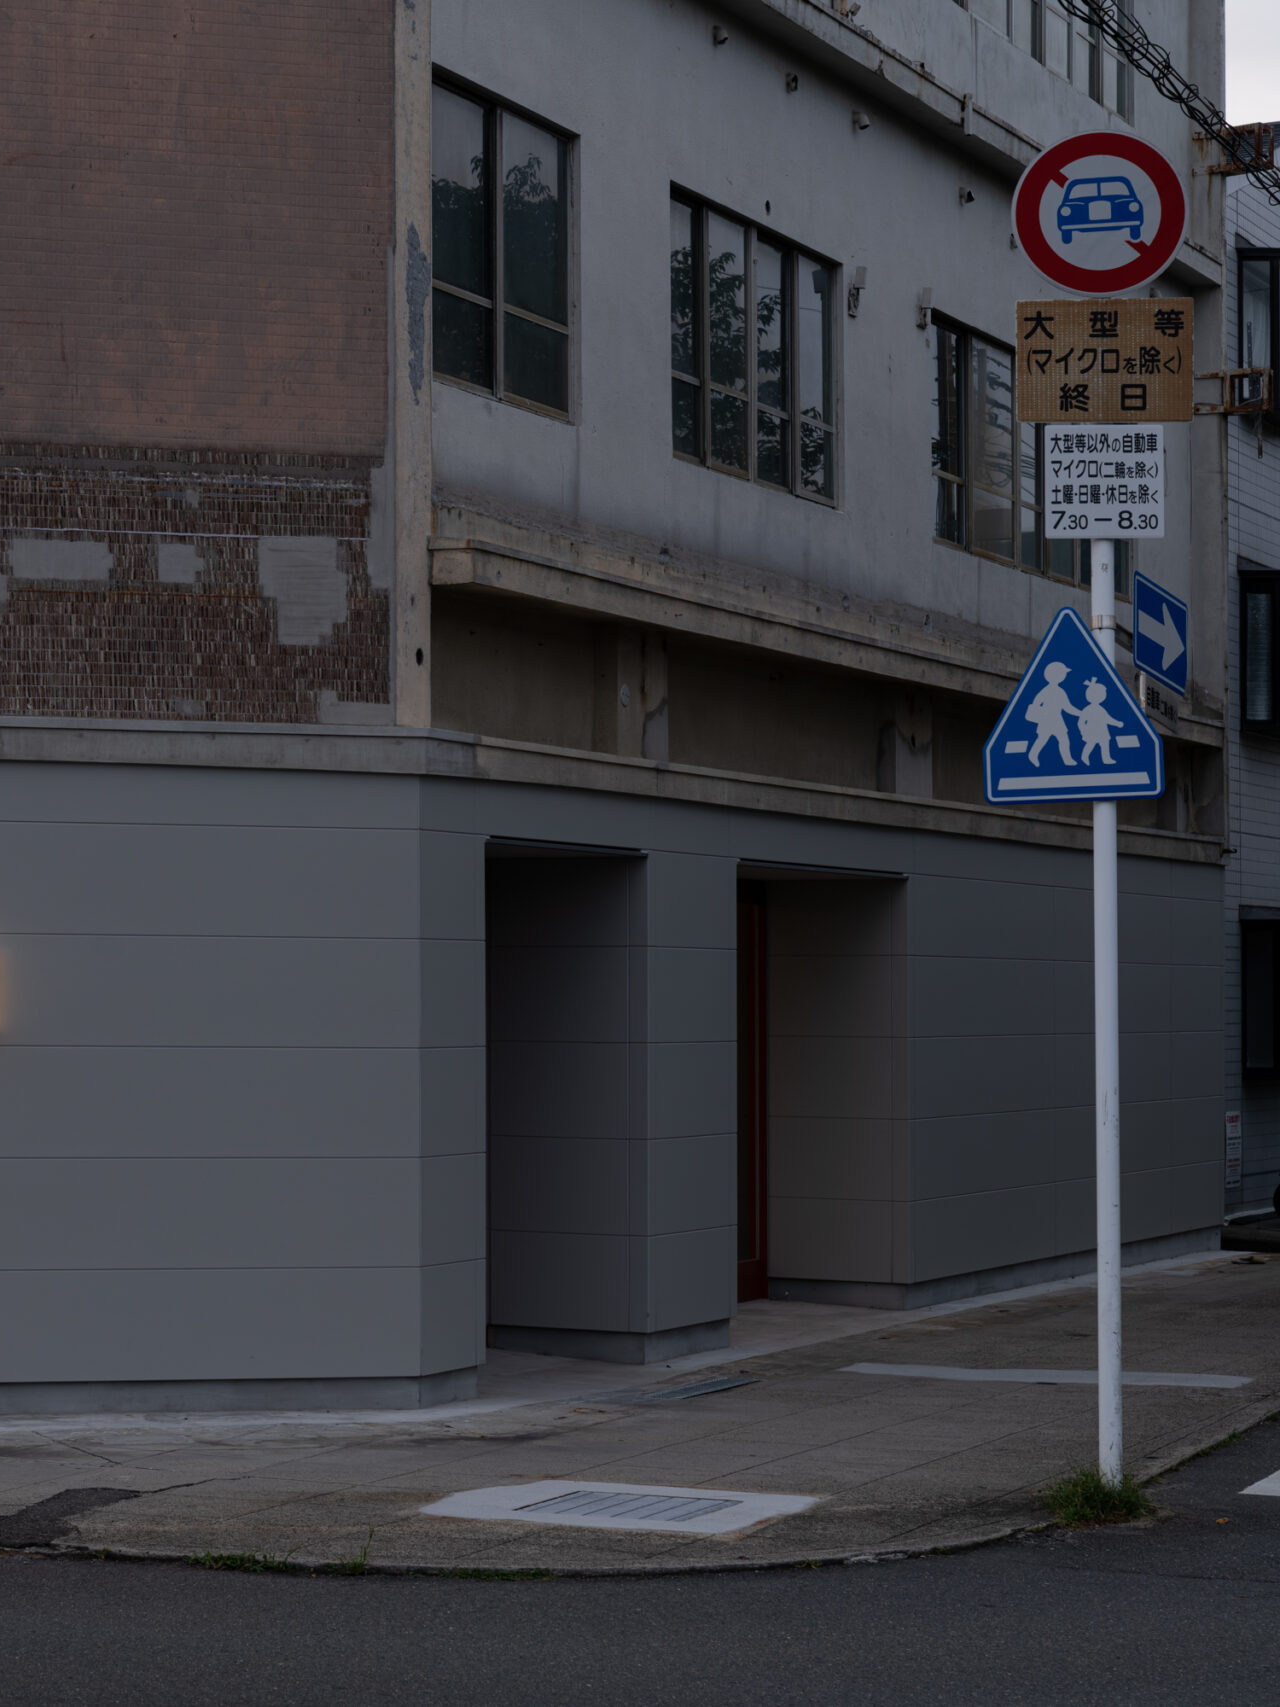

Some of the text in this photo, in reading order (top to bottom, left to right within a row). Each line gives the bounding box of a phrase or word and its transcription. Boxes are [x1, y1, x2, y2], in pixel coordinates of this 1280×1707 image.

[1023, 309, 1185, 340] 大型等
[1027, 346, 1182, 376] (マイクロを除く)
[1059, 383, 1147, 412] 終日
[1050, 433, 1158, 454] 大型等以外の自動車
[1050, 460, 1159, 480] マイクロ(二輪を除く)
